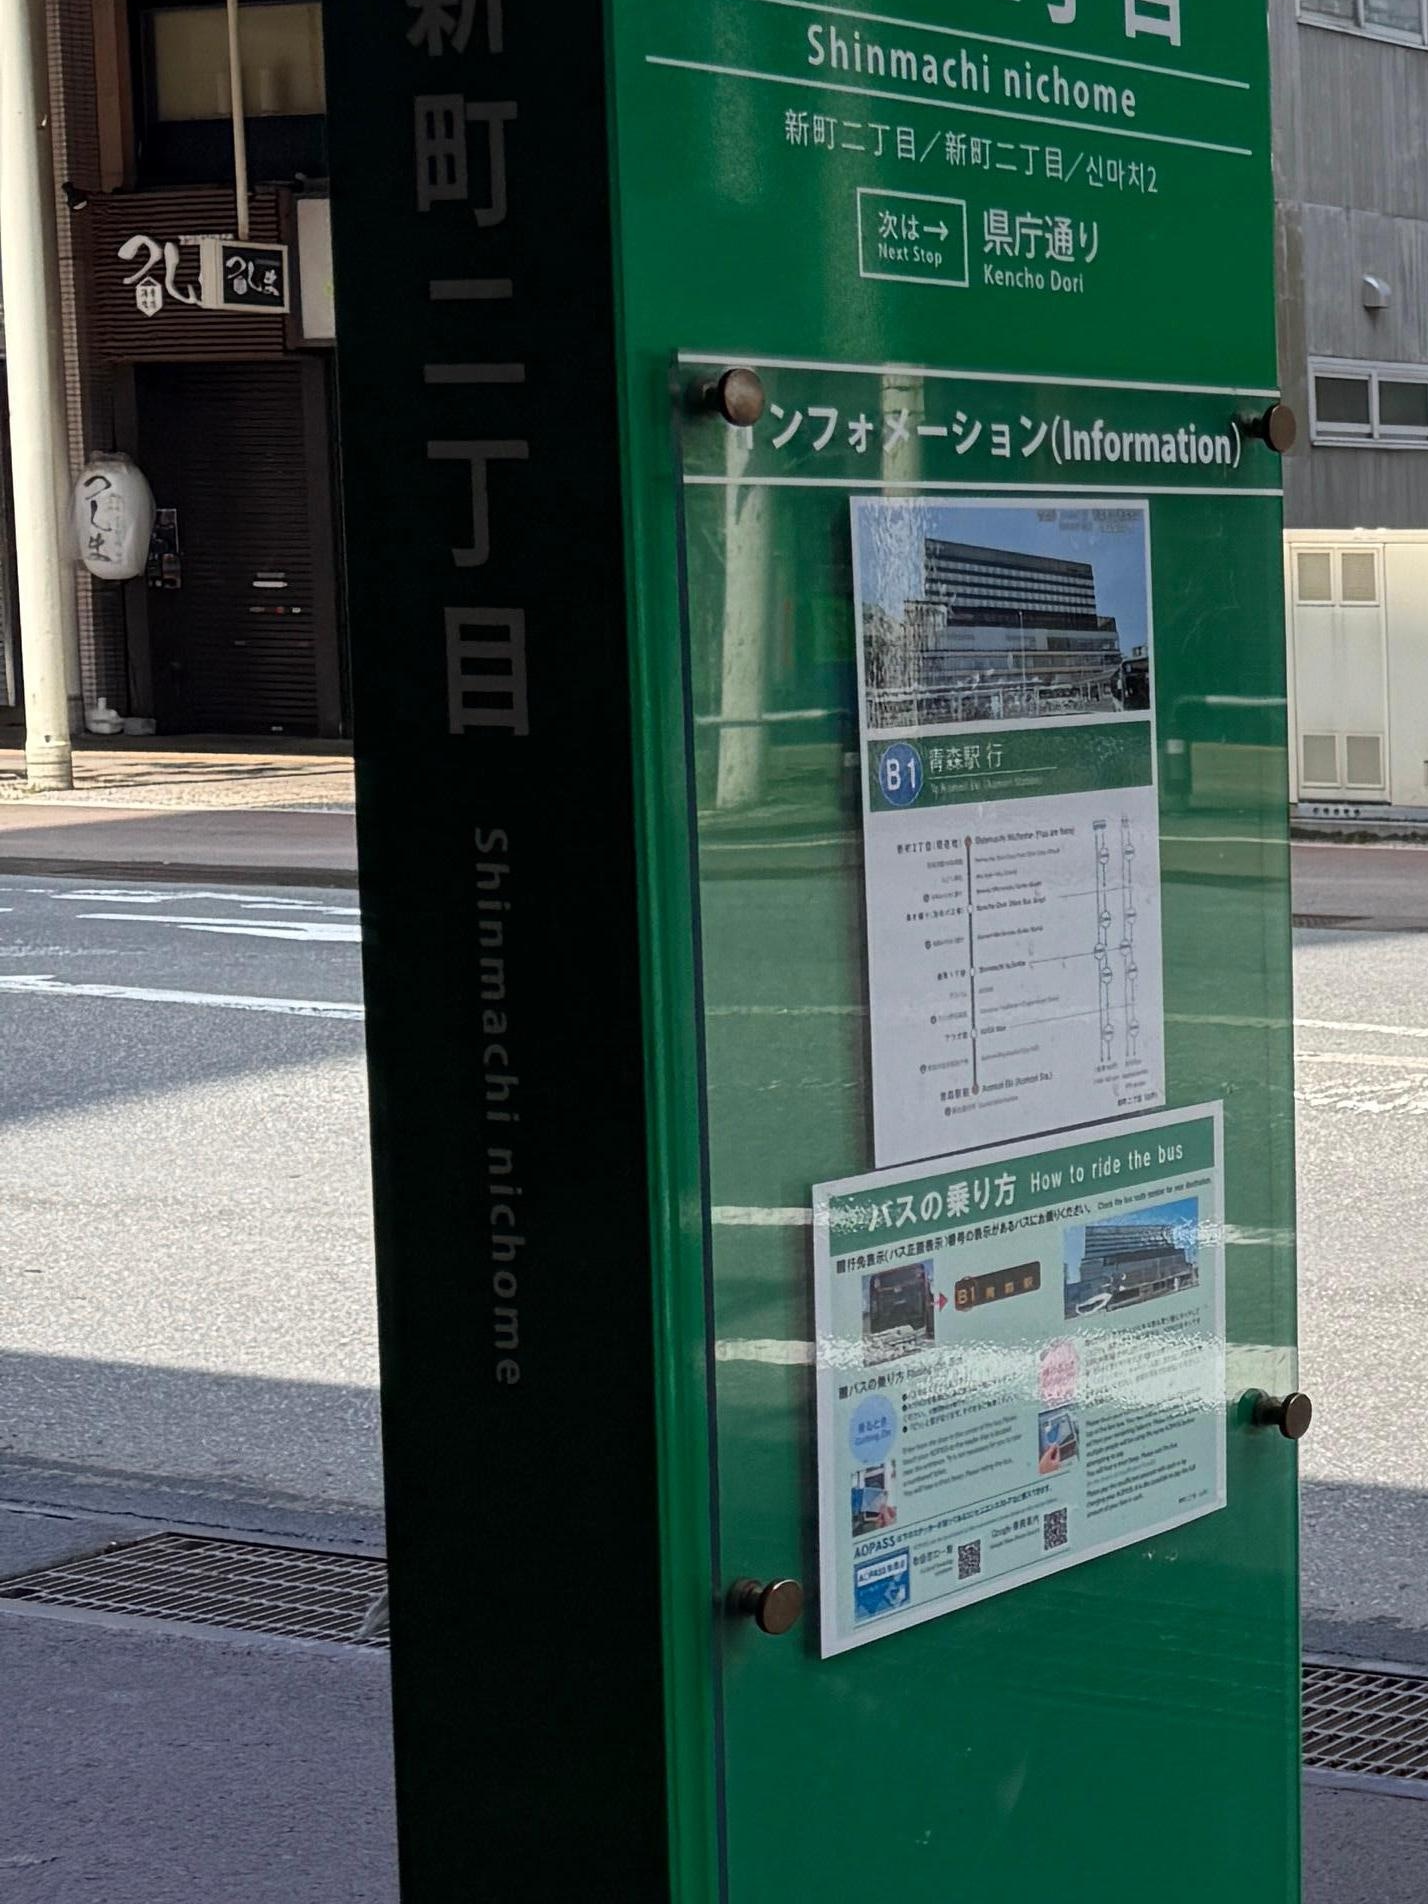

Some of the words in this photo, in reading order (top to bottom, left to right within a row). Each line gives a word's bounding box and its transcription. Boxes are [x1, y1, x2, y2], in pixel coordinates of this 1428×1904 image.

[807, 24, 991, 94] Shinmachi
[1004, 64, 1137, 118] nichome
[878, 210, 920, 241] 次は
[983, 208, 1099, 264] 県庁通り
[878, 242, 910, 263] Next
[912, 246, 943, 268] Stop
[983, 263, 1046, 291] Kencho
[1050, 268, 1085, 295] Dori
[886, 757, 917, 792] B1
[929, 745, 981, 774] 青森駅
[986, 742, 1003, 769] 行
[474, 825, 521, 1123] Shinmachi
[1030, 1170, 1062, 1194] How
[1069, 1164, 1085, 1183] to
[1091, 1153, 1121, 1180] ride
[1128, 1148, 1151, 1170] the
[1158, 1143, 1184, 1164] bus
[870, 1173, 1016, 1232] バスの乗り方
[487, 1145, 526, 1386] nichome
